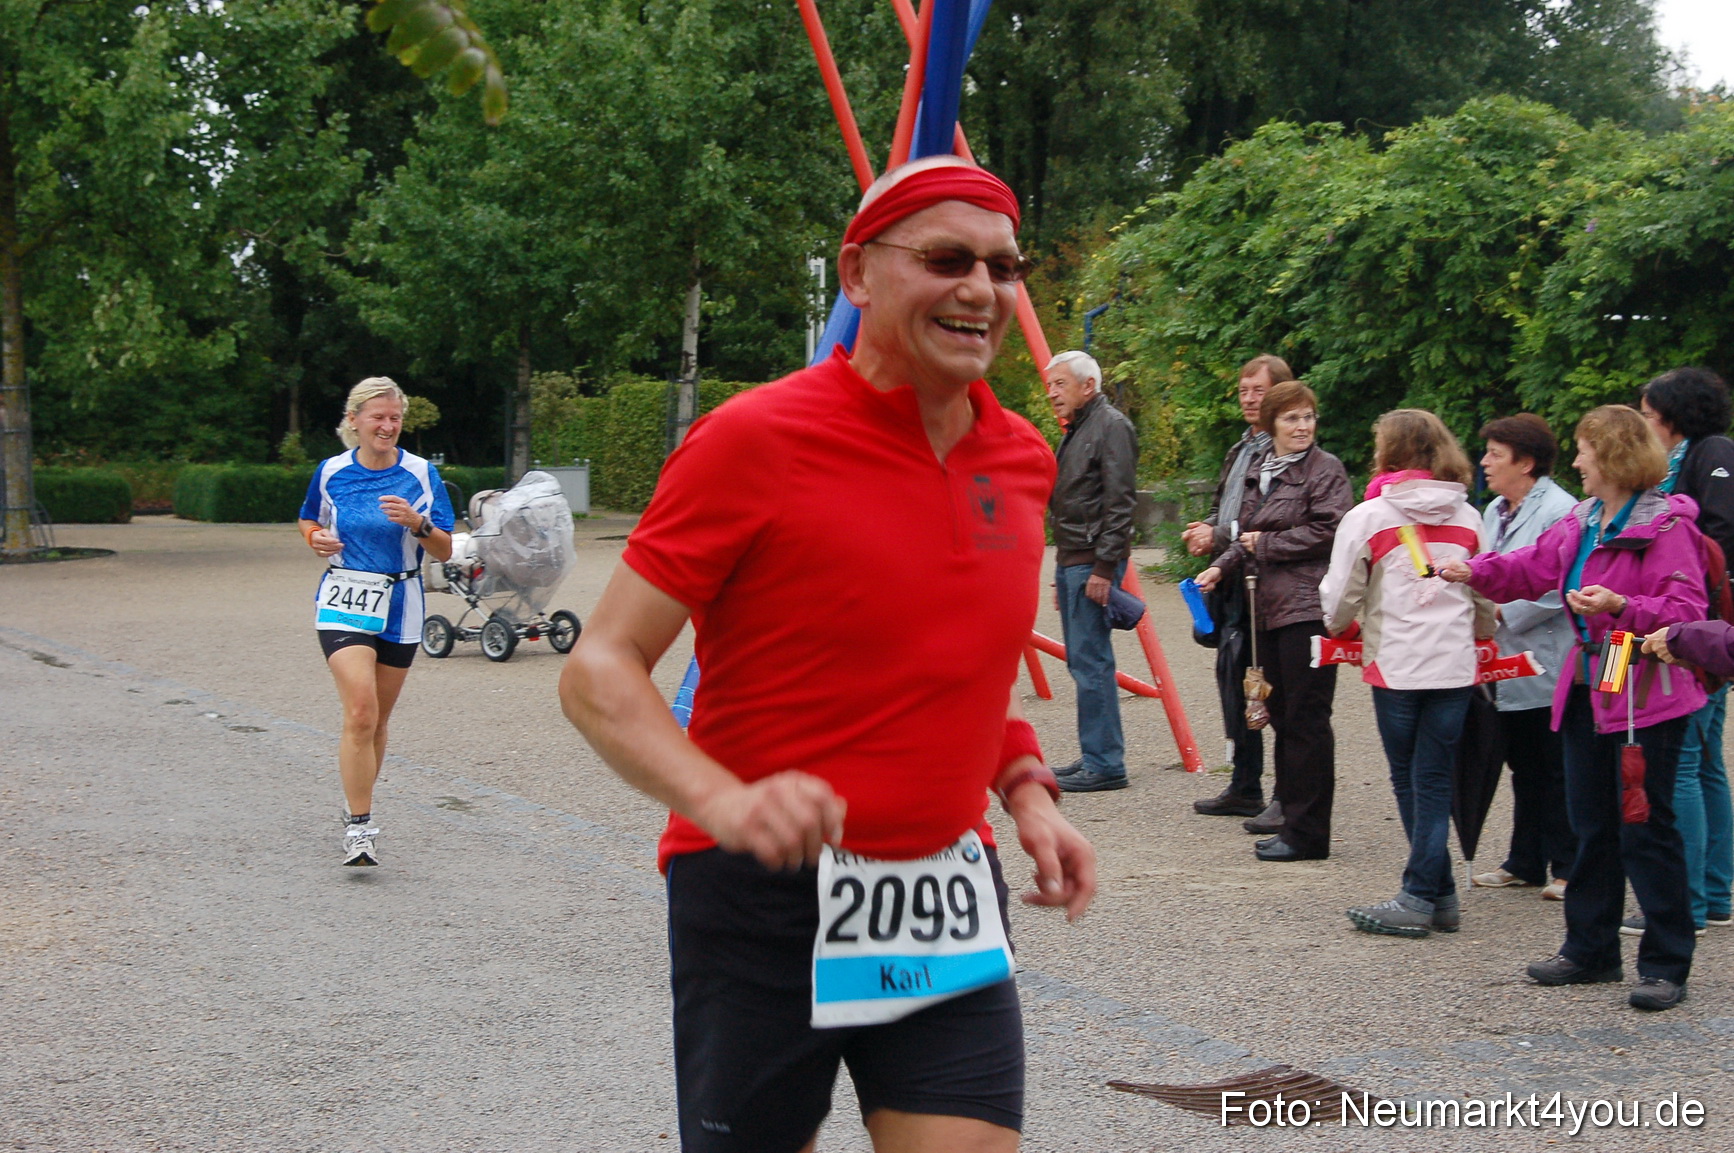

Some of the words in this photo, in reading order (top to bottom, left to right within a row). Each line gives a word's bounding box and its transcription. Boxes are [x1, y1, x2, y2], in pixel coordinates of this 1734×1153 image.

[327, 585, 384, 612] 2447
[825, 874, 980, 944] 2099
[880, 963, 933, 991] Karl
